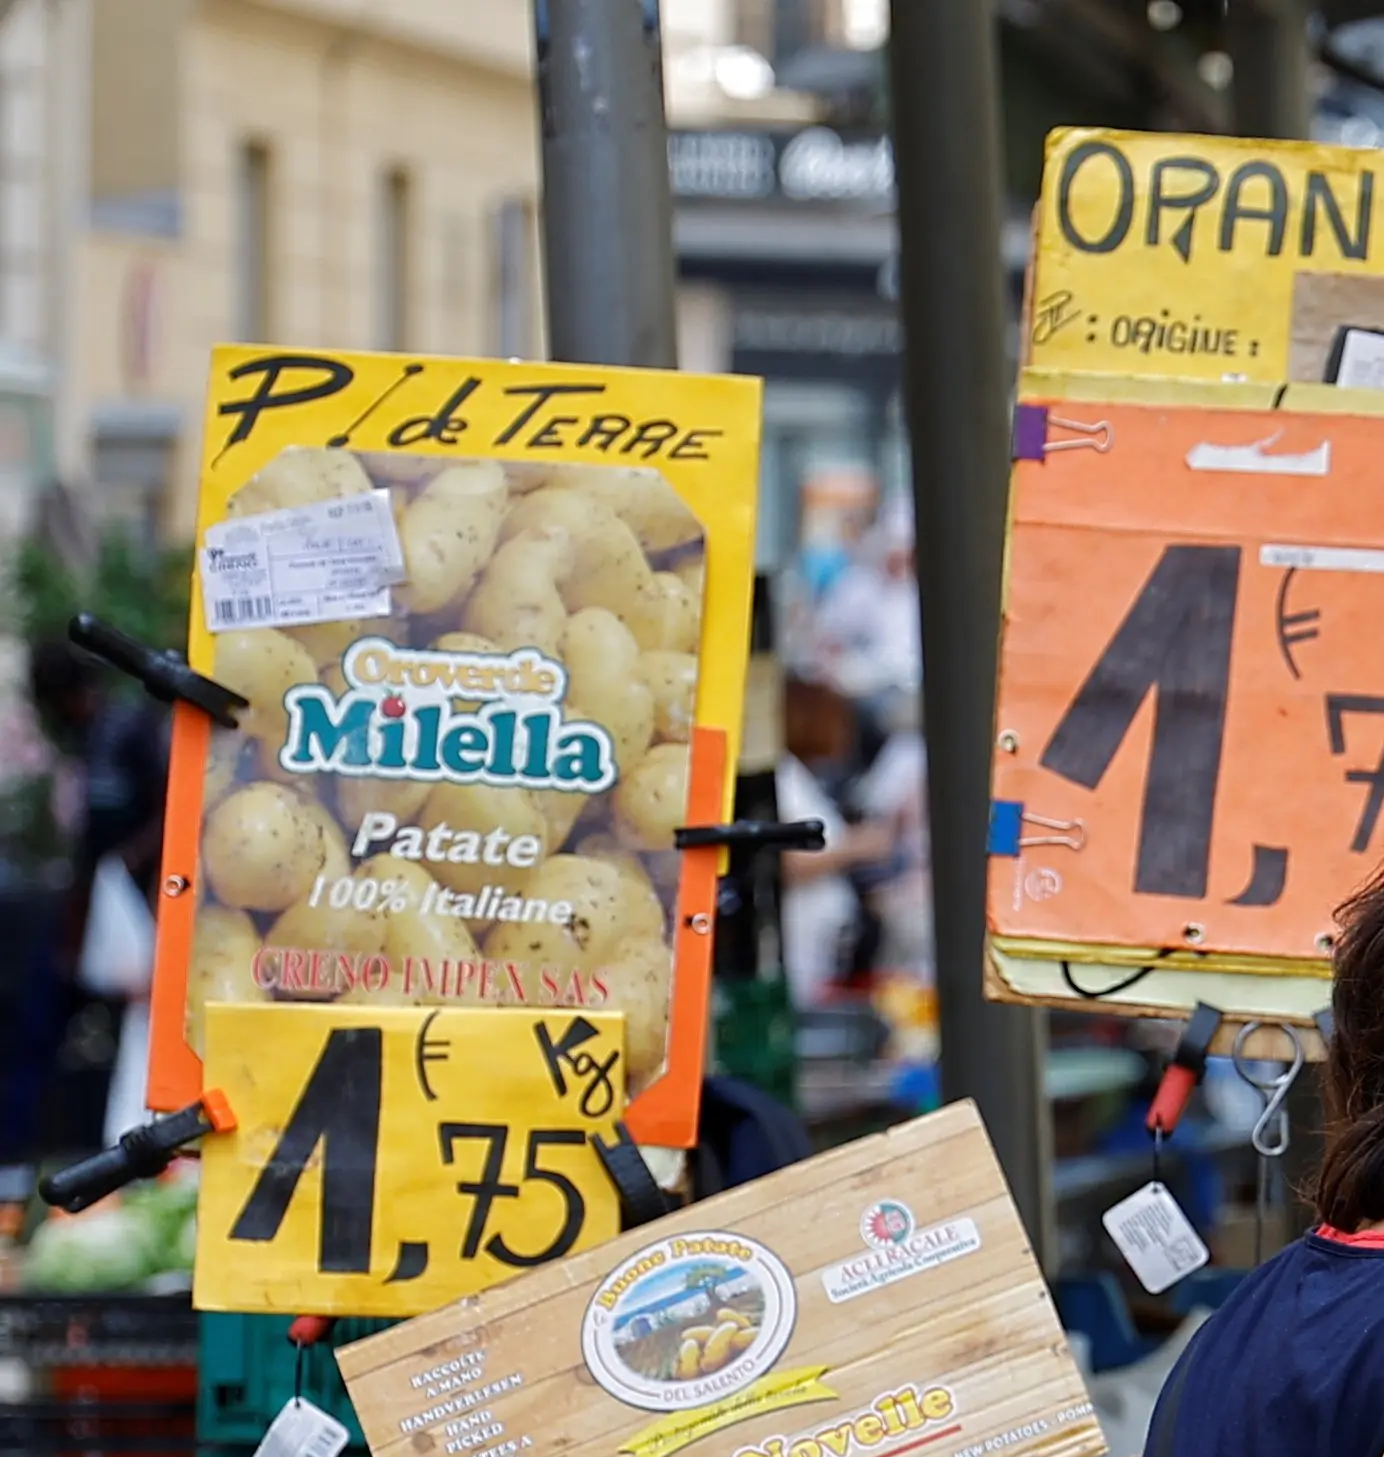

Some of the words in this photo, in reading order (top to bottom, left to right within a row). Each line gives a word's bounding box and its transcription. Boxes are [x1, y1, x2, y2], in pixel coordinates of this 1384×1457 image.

[386, 376, 483, 448] de
[492, 382, 725, 461] TERRE
[353, 645, 558, 697] Oroverde
[290, 694, 612, 784] Milella
[352, 812, 540, 869] Patate
[309, 877, 412, 915] 100%
[420, 886, 571, 927] Italiane
[251, 947, 390, 992] CRENO
[402, 955, 524, 1002] IMPEX
[540, 965, 609, 1004] SAS
[533, 1016, 620, 1117] Kg
[599, 1250, 665, 1310] Buone
[672, 1238, 753, 1261] Patate
[411, 1350, 486, 1388] RACCOLTE
[438, 1367, 483, 1393] MANO
[663, 1386, 690, 1403] DEL
[694, 1360, 756, 1397] SALENTO
[400, 1373, 523, 1433] HANDVERLESEN
[445, 1410, 492, 1437] HAND
[446, 1423, 503, 1454] PICKED
[985, 1418, 1048, 1451] POTATOES
